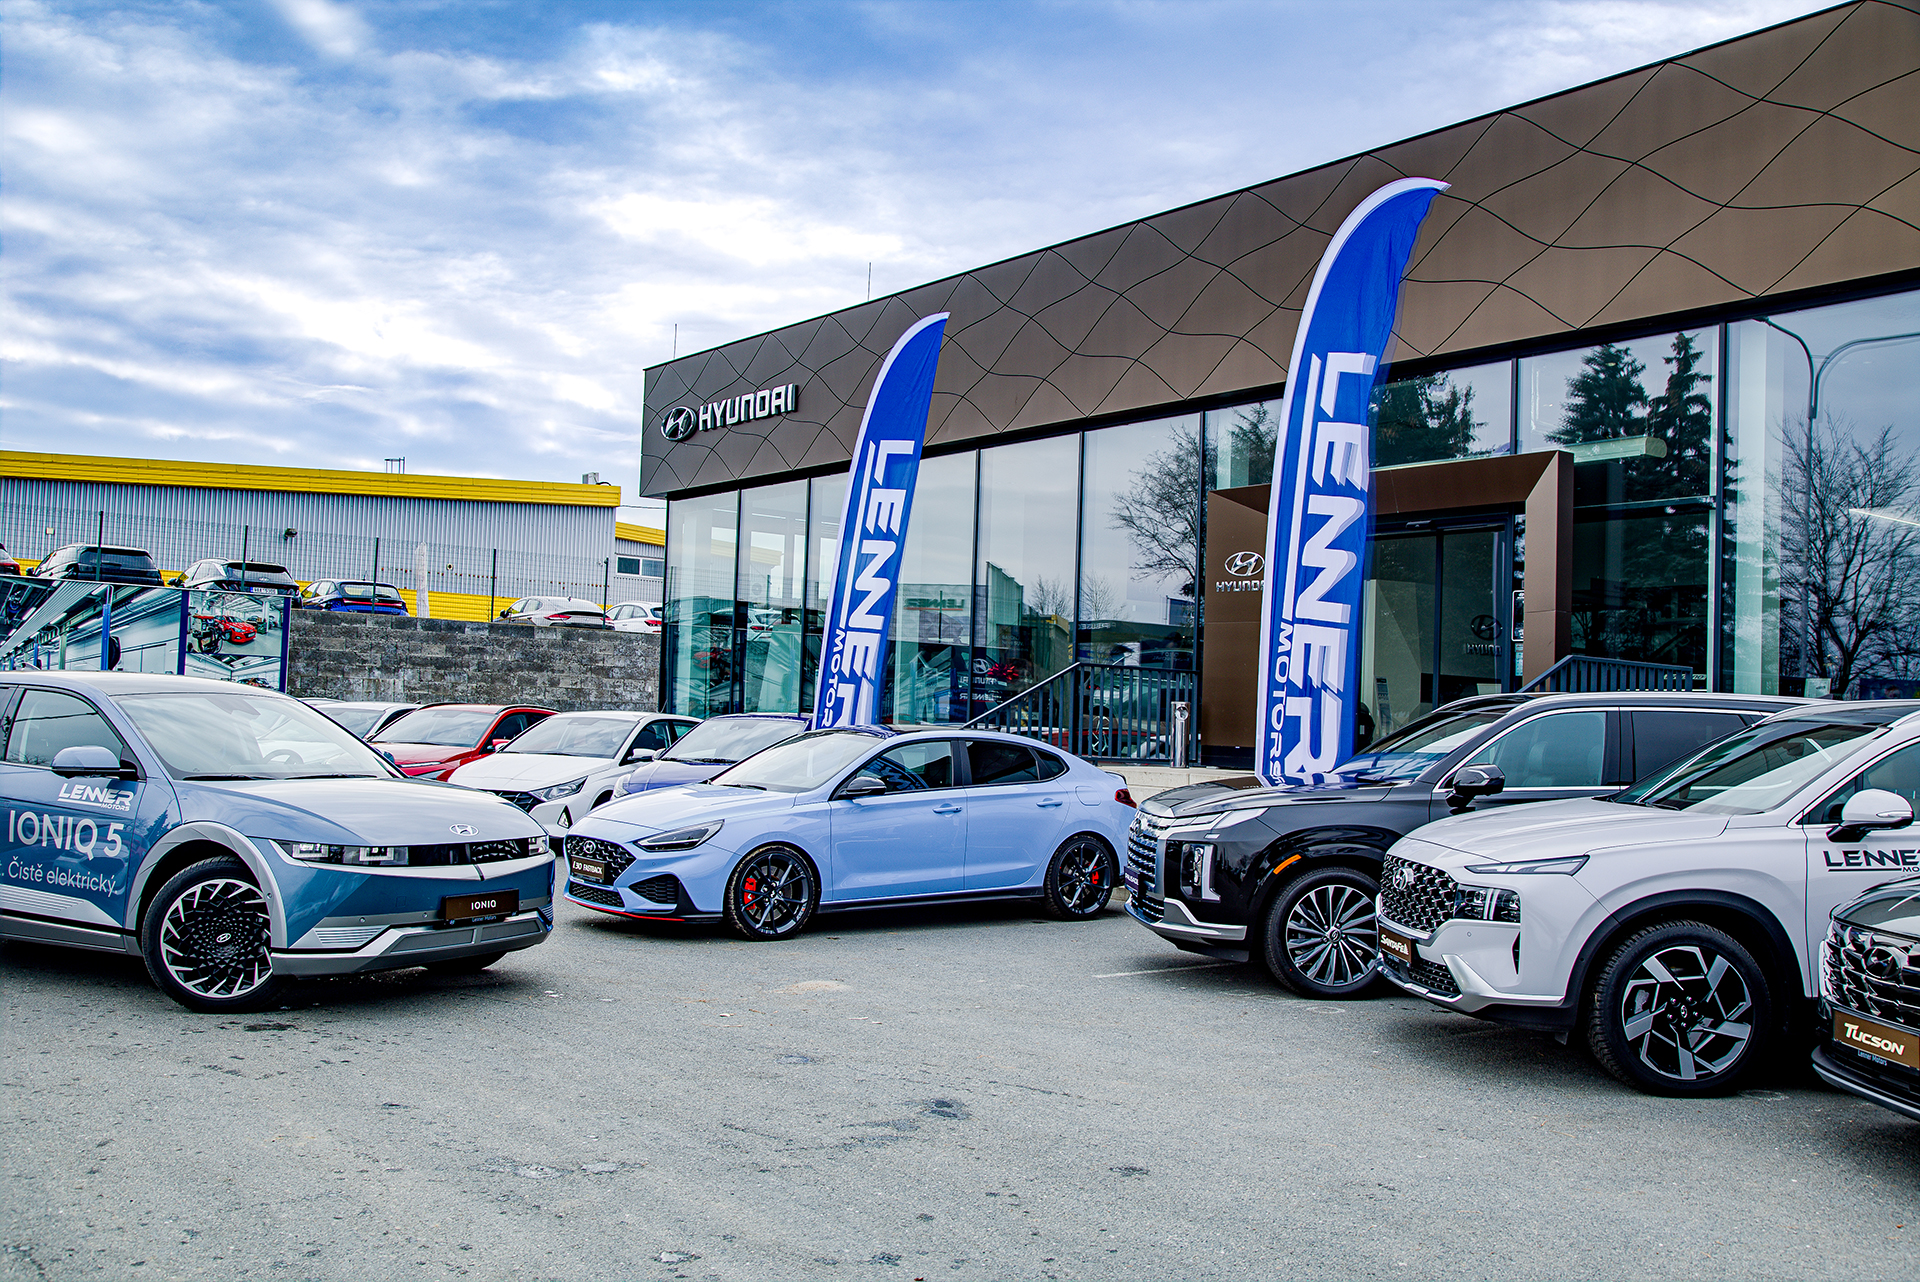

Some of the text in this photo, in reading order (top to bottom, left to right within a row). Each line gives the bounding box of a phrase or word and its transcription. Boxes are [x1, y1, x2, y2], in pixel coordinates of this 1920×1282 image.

[699, 383, 798, 431] HYUNDAI
[1284, 352, 1377, 777] LENNER
[1215, 580, 1265, 592] HYUND
[1466, 643, 1502, 656] HYUND
[820, 628, 847, 728] MOTOR
[58, 783, 135, 806] LENNER
[100, 803, 131, 812] MOTORS
[8, 810, 125, 861] IONIQ 5
[1822, 849, 1920, 867] LENNE
[8, 855, 43, 882] Čistě
[46, 866, 118, 898] elektrický.
[471, 899, 497, 911] IONIQ
